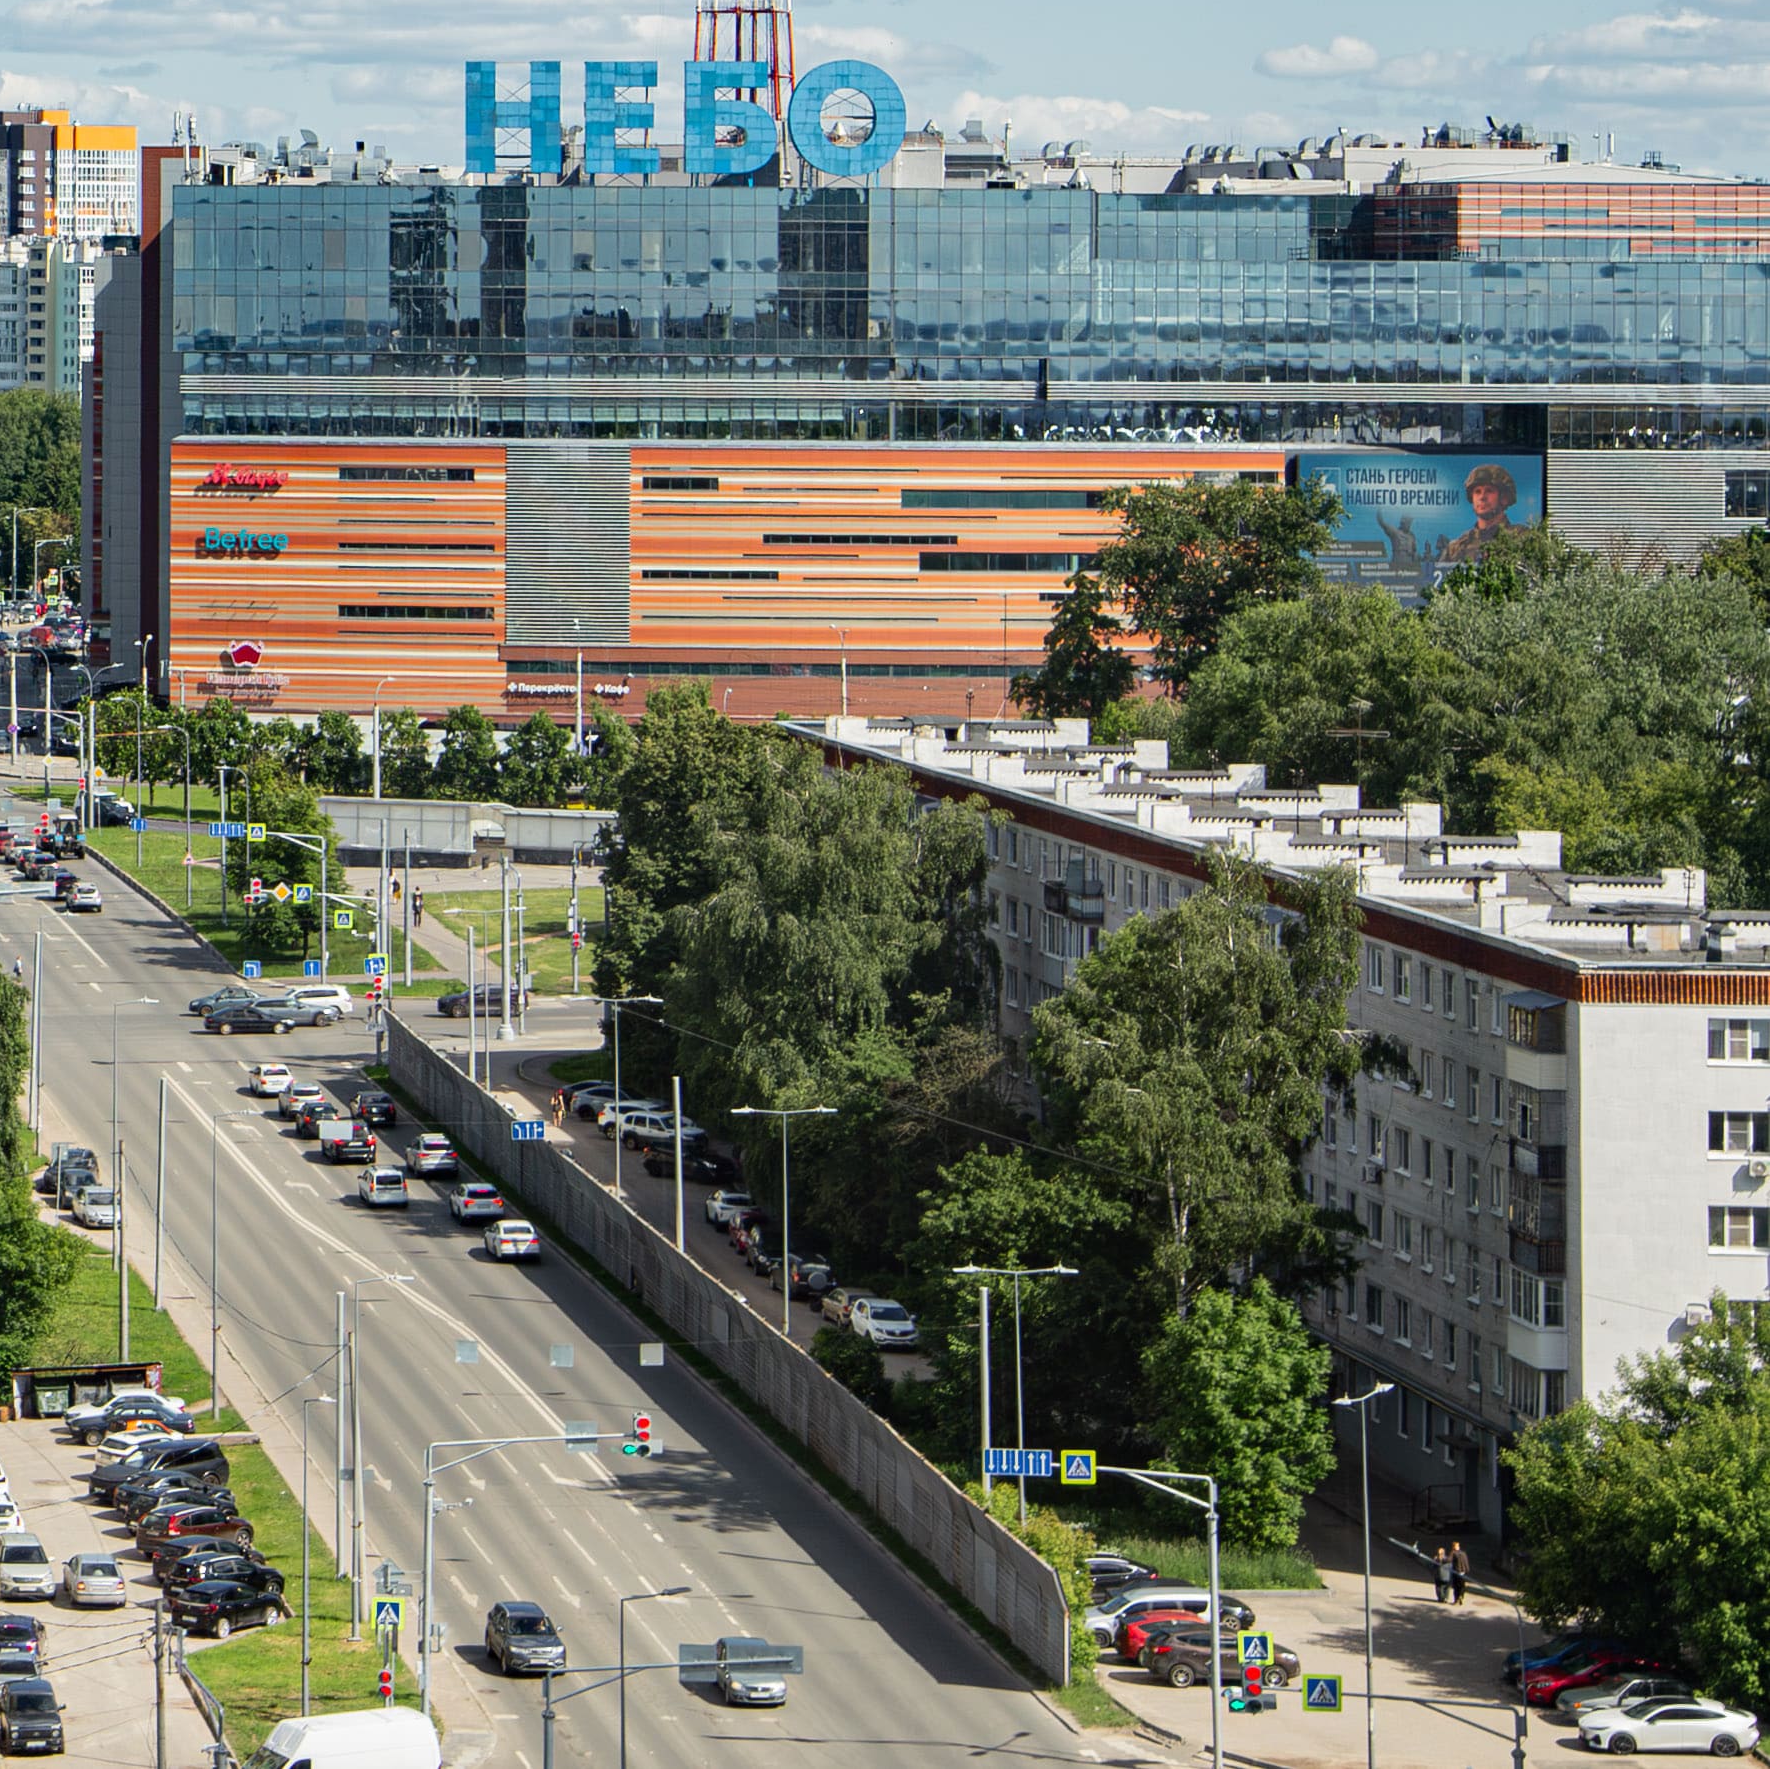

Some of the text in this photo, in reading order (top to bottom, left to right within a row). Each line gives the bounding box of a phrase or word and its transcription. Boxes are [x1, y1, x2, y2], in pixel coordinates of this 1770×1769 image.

[465, 59, 908, 176] НЕБО
[1345, 467, 1437, 485] СТАНЬ ГЕРОЕМ
[1345, 488, 1460, 506] НАШЕГО ВРЕМЕНИ
[204, 526, 289, 551] Befree
[518, 682, 578, 695] Перекрёсто
